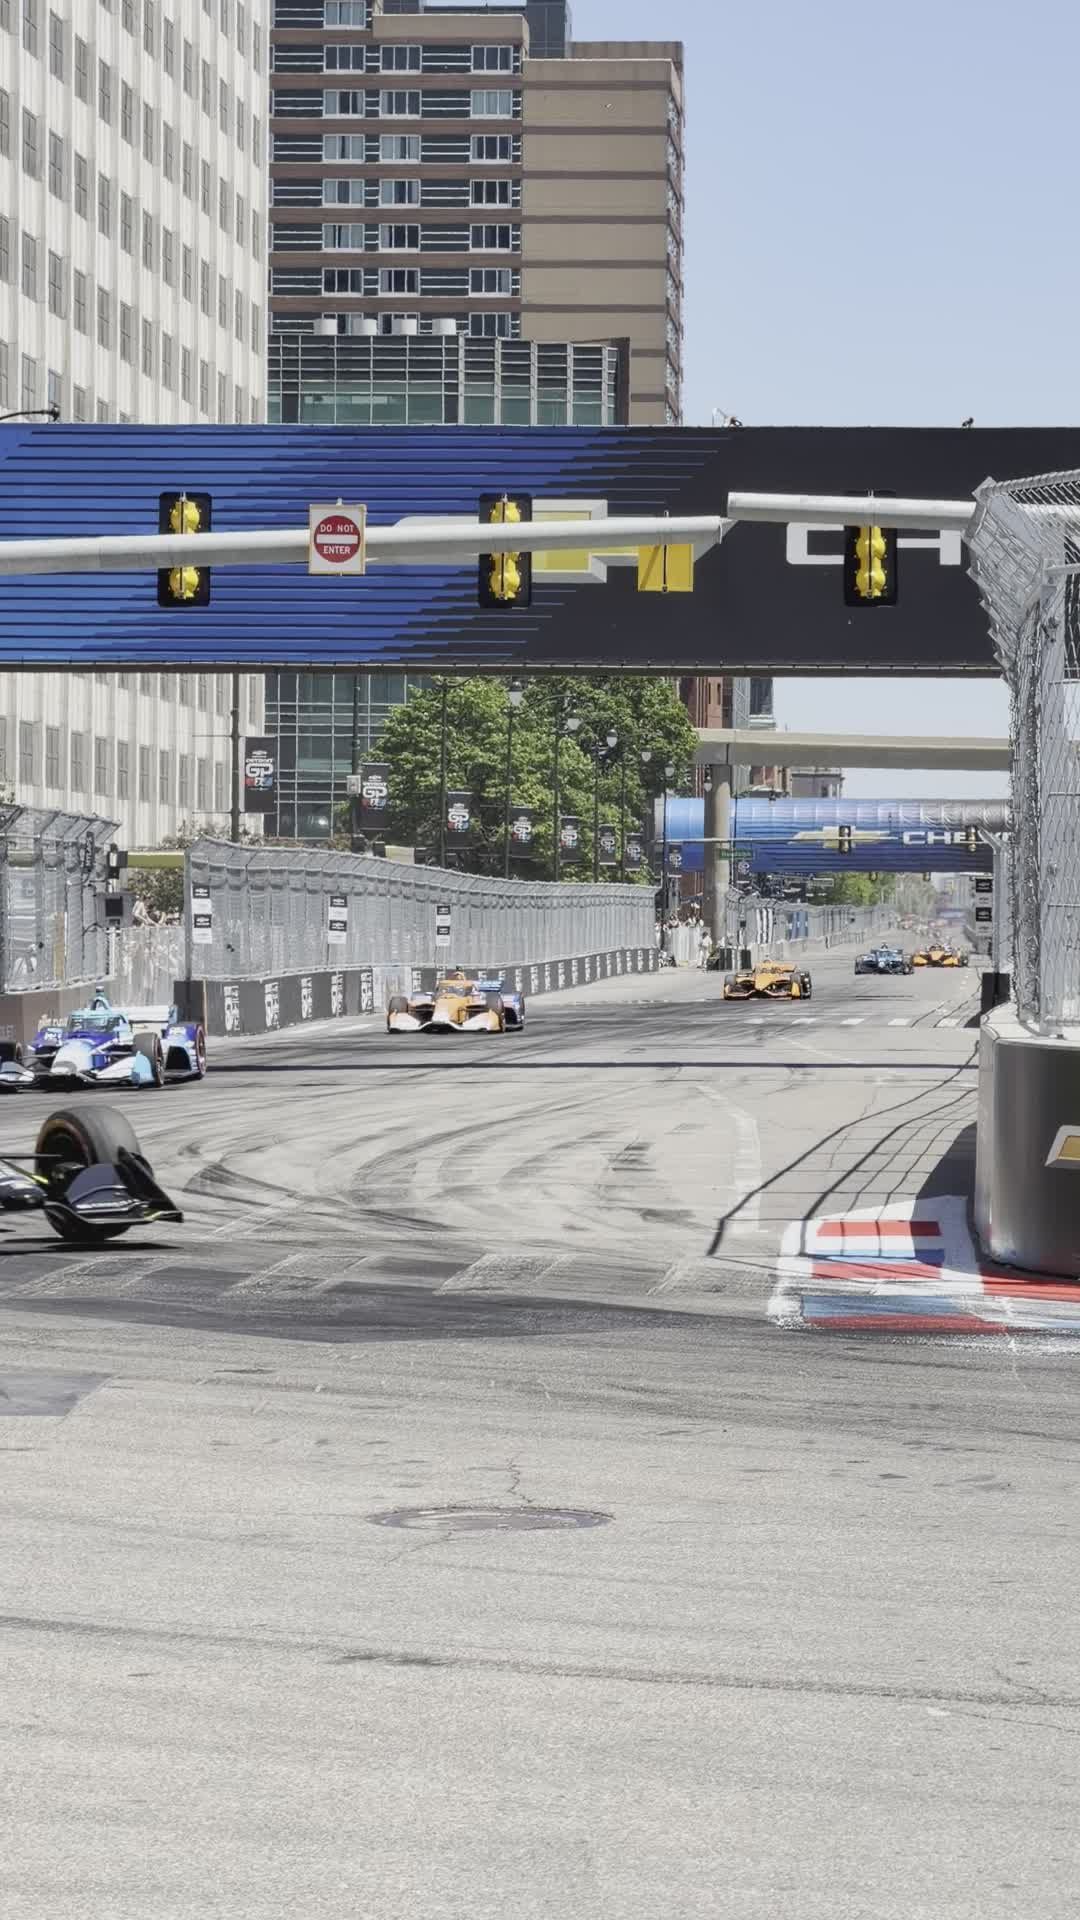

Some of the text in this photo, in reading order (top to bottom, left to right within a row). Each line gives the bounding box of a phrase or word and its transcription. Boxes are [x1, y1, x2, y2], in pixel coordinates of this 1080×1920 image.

[320, 524, 354, 532] DO NOT
[323, 545, 351, 554] ENTER
[245, 763, 274, 778] GP
[362, 786, 388, 798] GP
